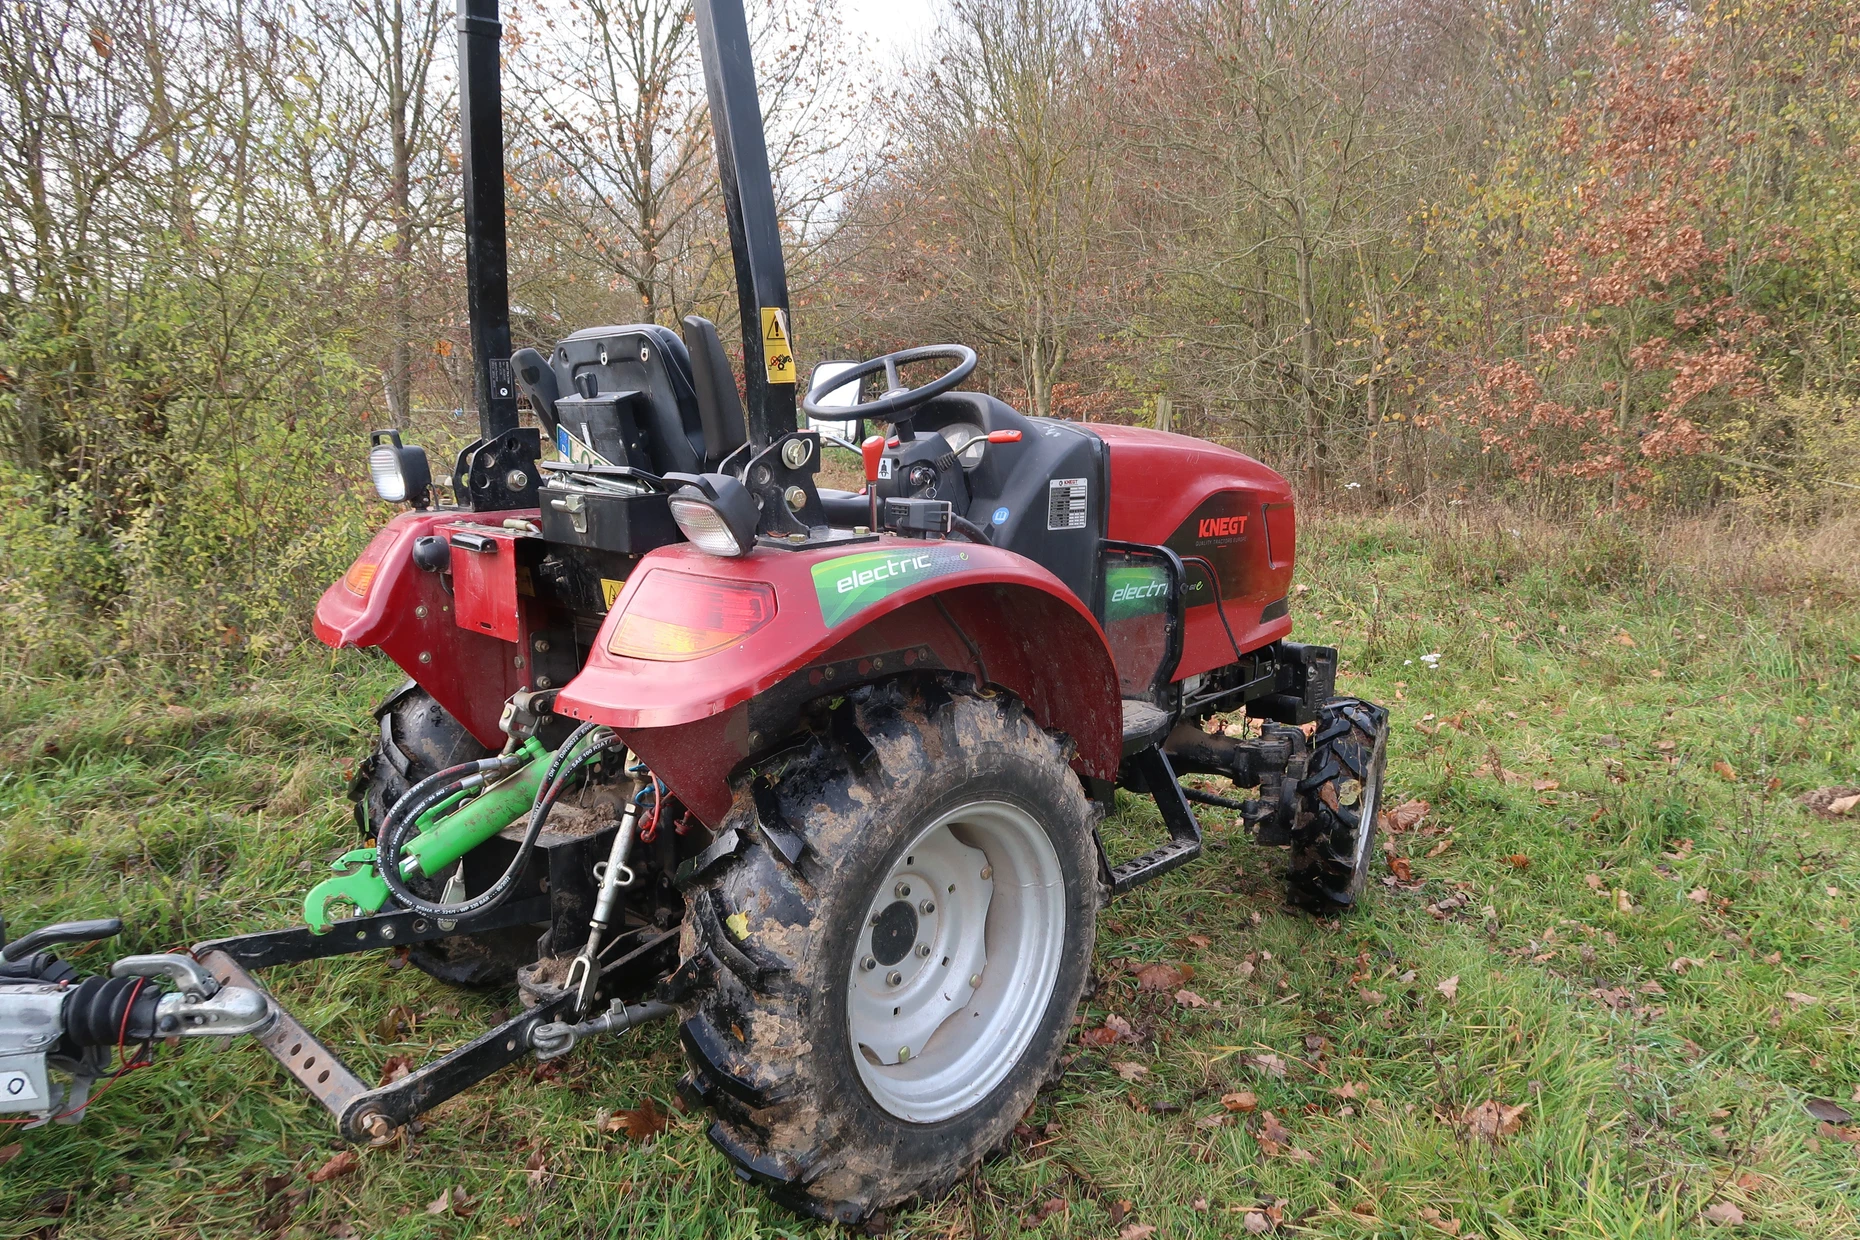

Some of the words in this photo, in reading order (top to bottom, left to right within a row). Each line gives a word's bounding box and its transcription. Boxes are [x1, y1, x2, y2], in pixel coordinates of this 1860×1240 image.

[1198, 515, 1248, 538] KNEGT
[836, 554, 932, 594] electric
[1111, 580, 1169, 602] electri
[571, 757, 584, 768] SAE
[583, 749, 593, 758] 100
